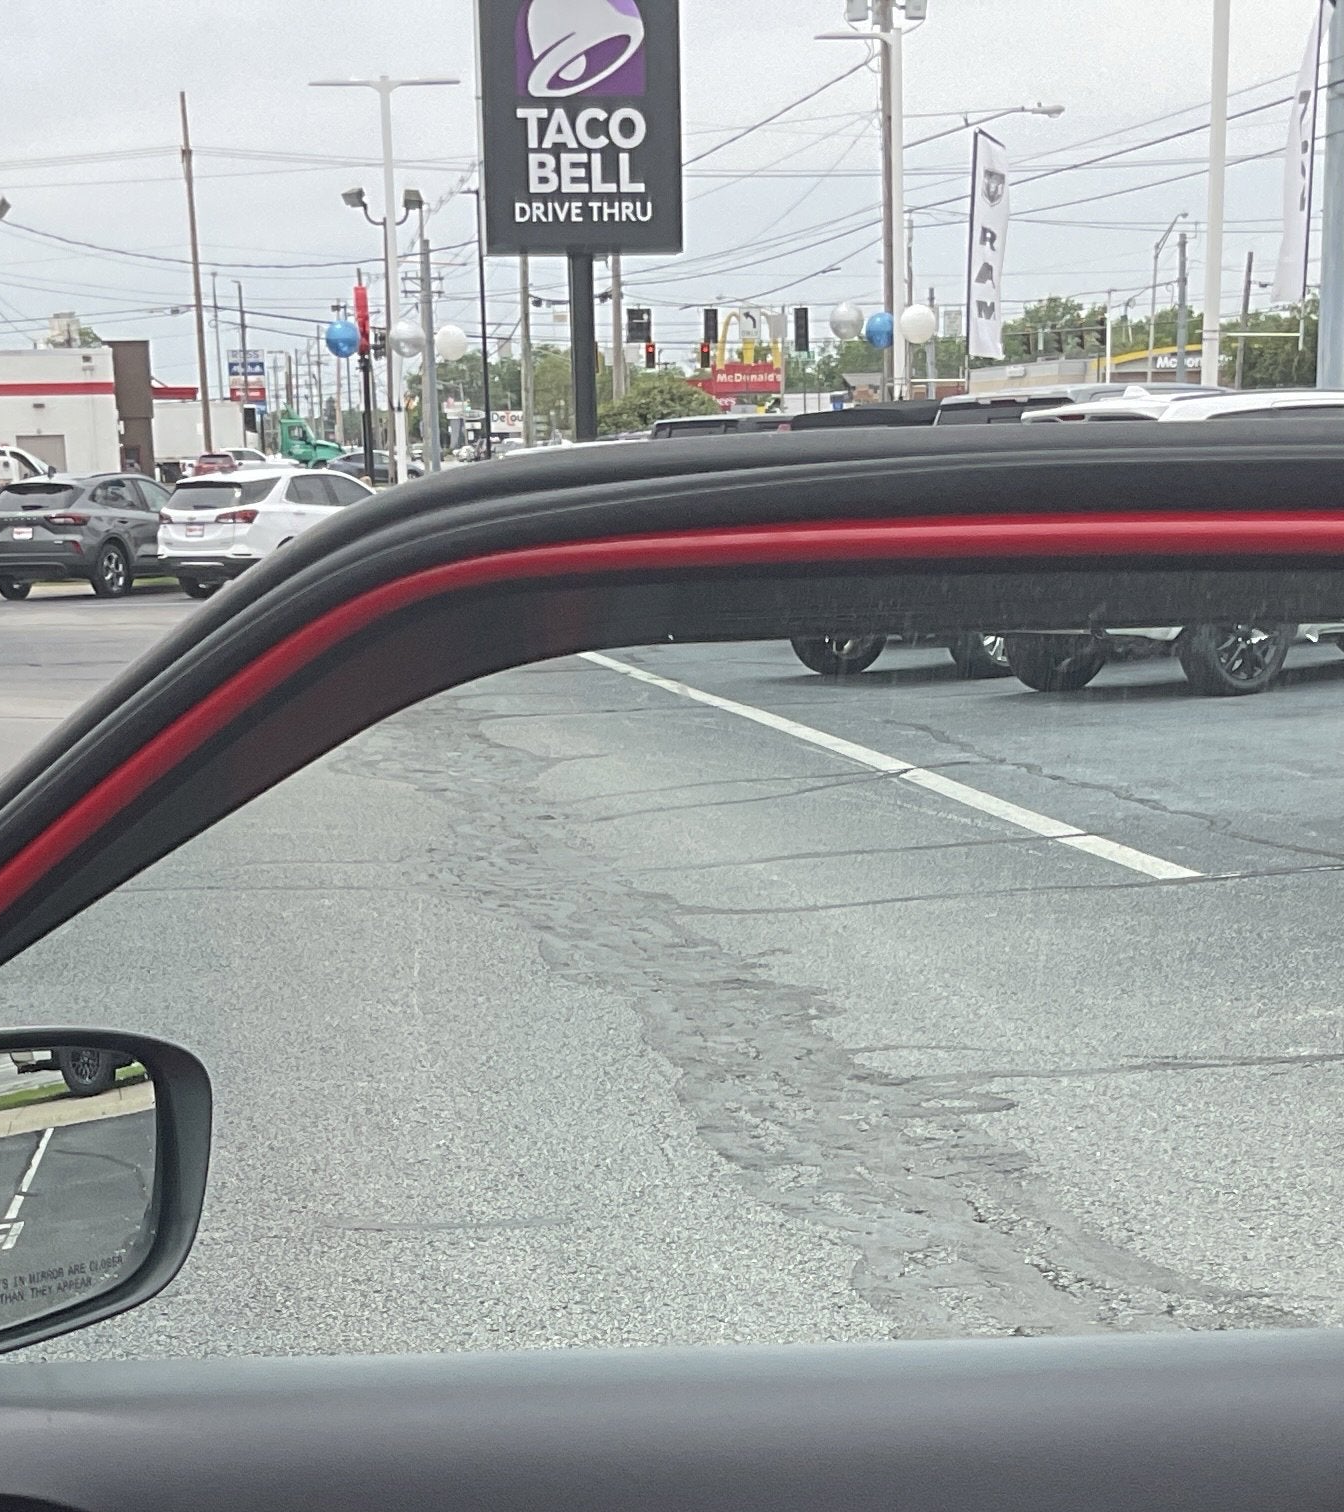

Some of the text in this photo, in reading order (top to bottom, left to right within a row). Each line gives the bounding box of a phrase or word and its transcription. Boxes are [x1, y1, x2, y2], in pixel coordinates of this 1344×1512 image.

[516, 107, 646, 149] TACO
[528, 152, 646, 194] BELL
[514, 201, 652, 223] DRIVE THRU
[974, 225, 998, 321] RAM
[0, 1276, 93, 1305] THAN THEY APPEAR
[13, 1276, 26, 1288] IN
[29, 1266, 65, 1285] MIRROR
[67, 1262, 86, 1276] ARE
